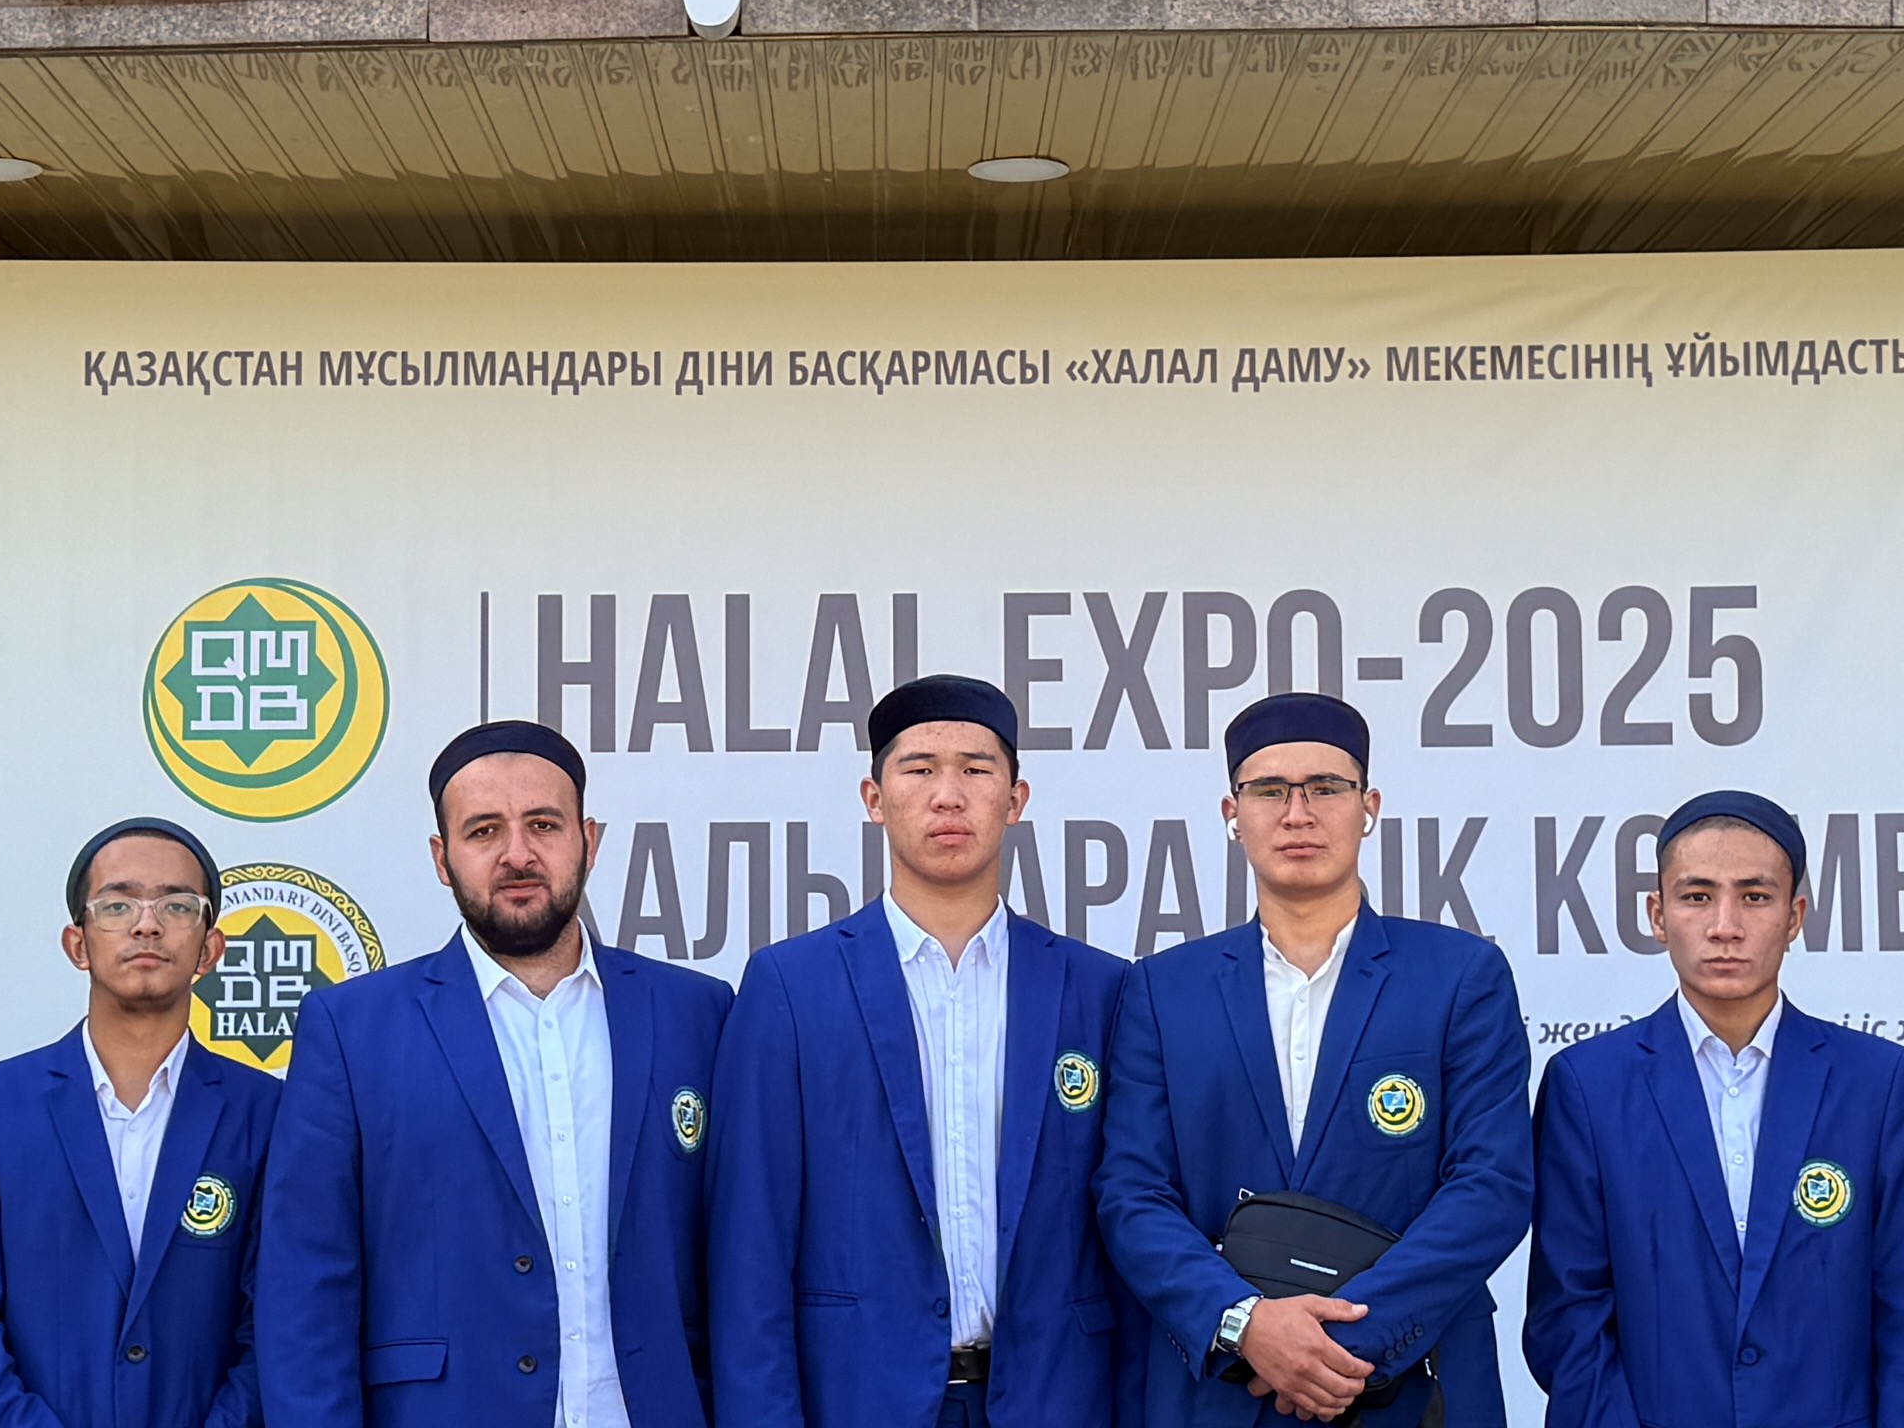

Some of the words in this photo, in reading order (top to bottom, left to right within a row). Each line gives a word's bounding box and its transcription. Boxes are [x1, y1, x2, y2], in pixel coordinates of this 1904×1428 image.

[82, 350, 304, 396] ҚАЗАҚСТАН
[319, 350, 663, 395] МҰСЫЛМАНДАРЫ
[674, 350, 775, 396] ДІНИ
[787, 348, 1051, 395] БАСҚАРМАСЫ
[1065, 347, 1218, 385] «ХАЛАЛ
[1231, 346, 1371, 393] ДАМУ»
[1385, 342, 1653, 388] МЕКЕМЕСІНІҢ
[1001, 584, 1764, 752] EXPO-2025
[309, 902, 342, 933] DINI
[216, 1012, 299, 1037] HALA
